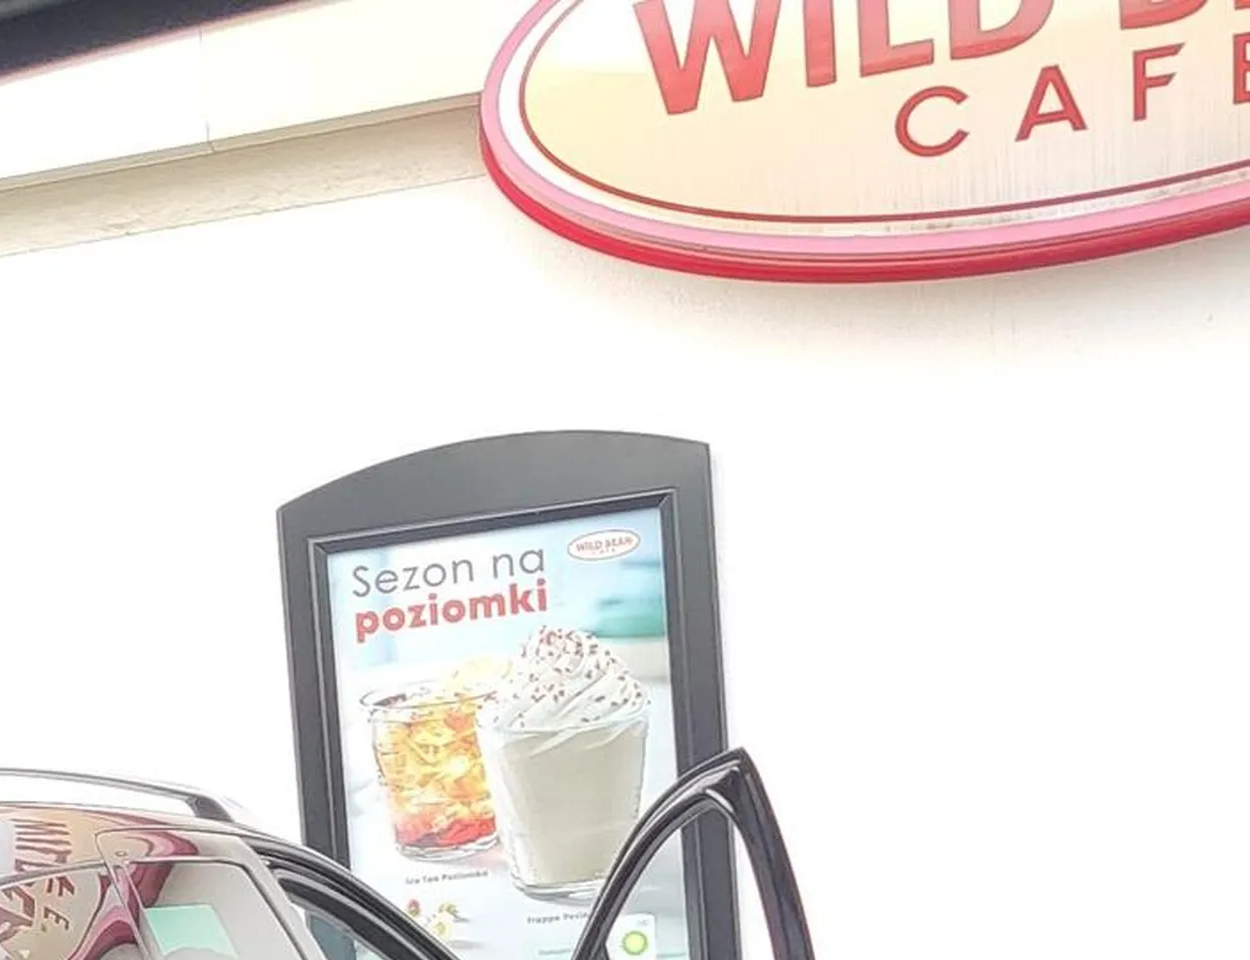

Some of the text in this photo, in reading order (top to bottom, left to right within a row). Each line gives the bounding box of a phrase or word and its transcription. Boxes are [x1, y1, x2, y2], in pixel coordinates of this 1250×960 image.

[633, 0, 1055, 115] WILD
[352, 549, 545, 597] Sezon na
[355, 578, 548, 645] poziomki
